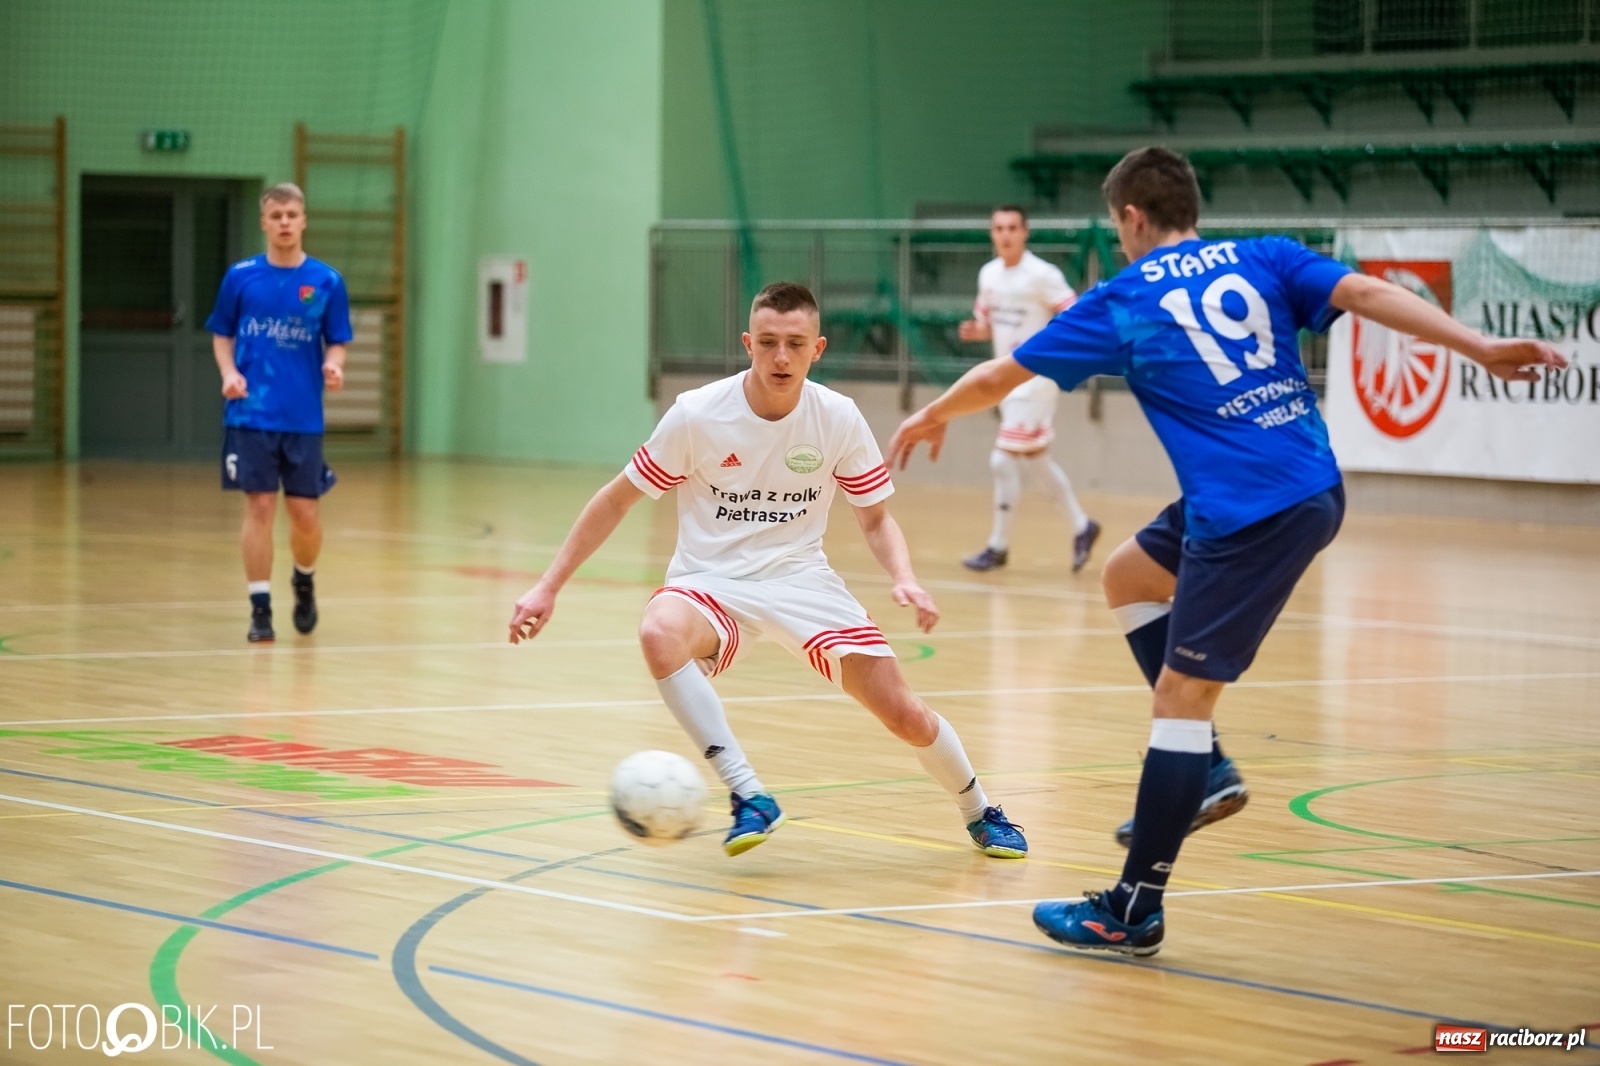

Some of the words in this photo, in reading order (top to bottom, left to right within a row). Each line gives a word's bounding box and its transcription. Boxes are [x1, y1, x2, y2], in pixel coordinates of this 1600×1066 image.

[1140, 241, 1240, 283] START
[1159, 272, 1277, 386] 19
[709, 484, 762, 504] Trawa
[767, 491, 778, 502] z
[783, 486, 822, 502] rolki
[715, 505, 808, 523] Pietraszyn
